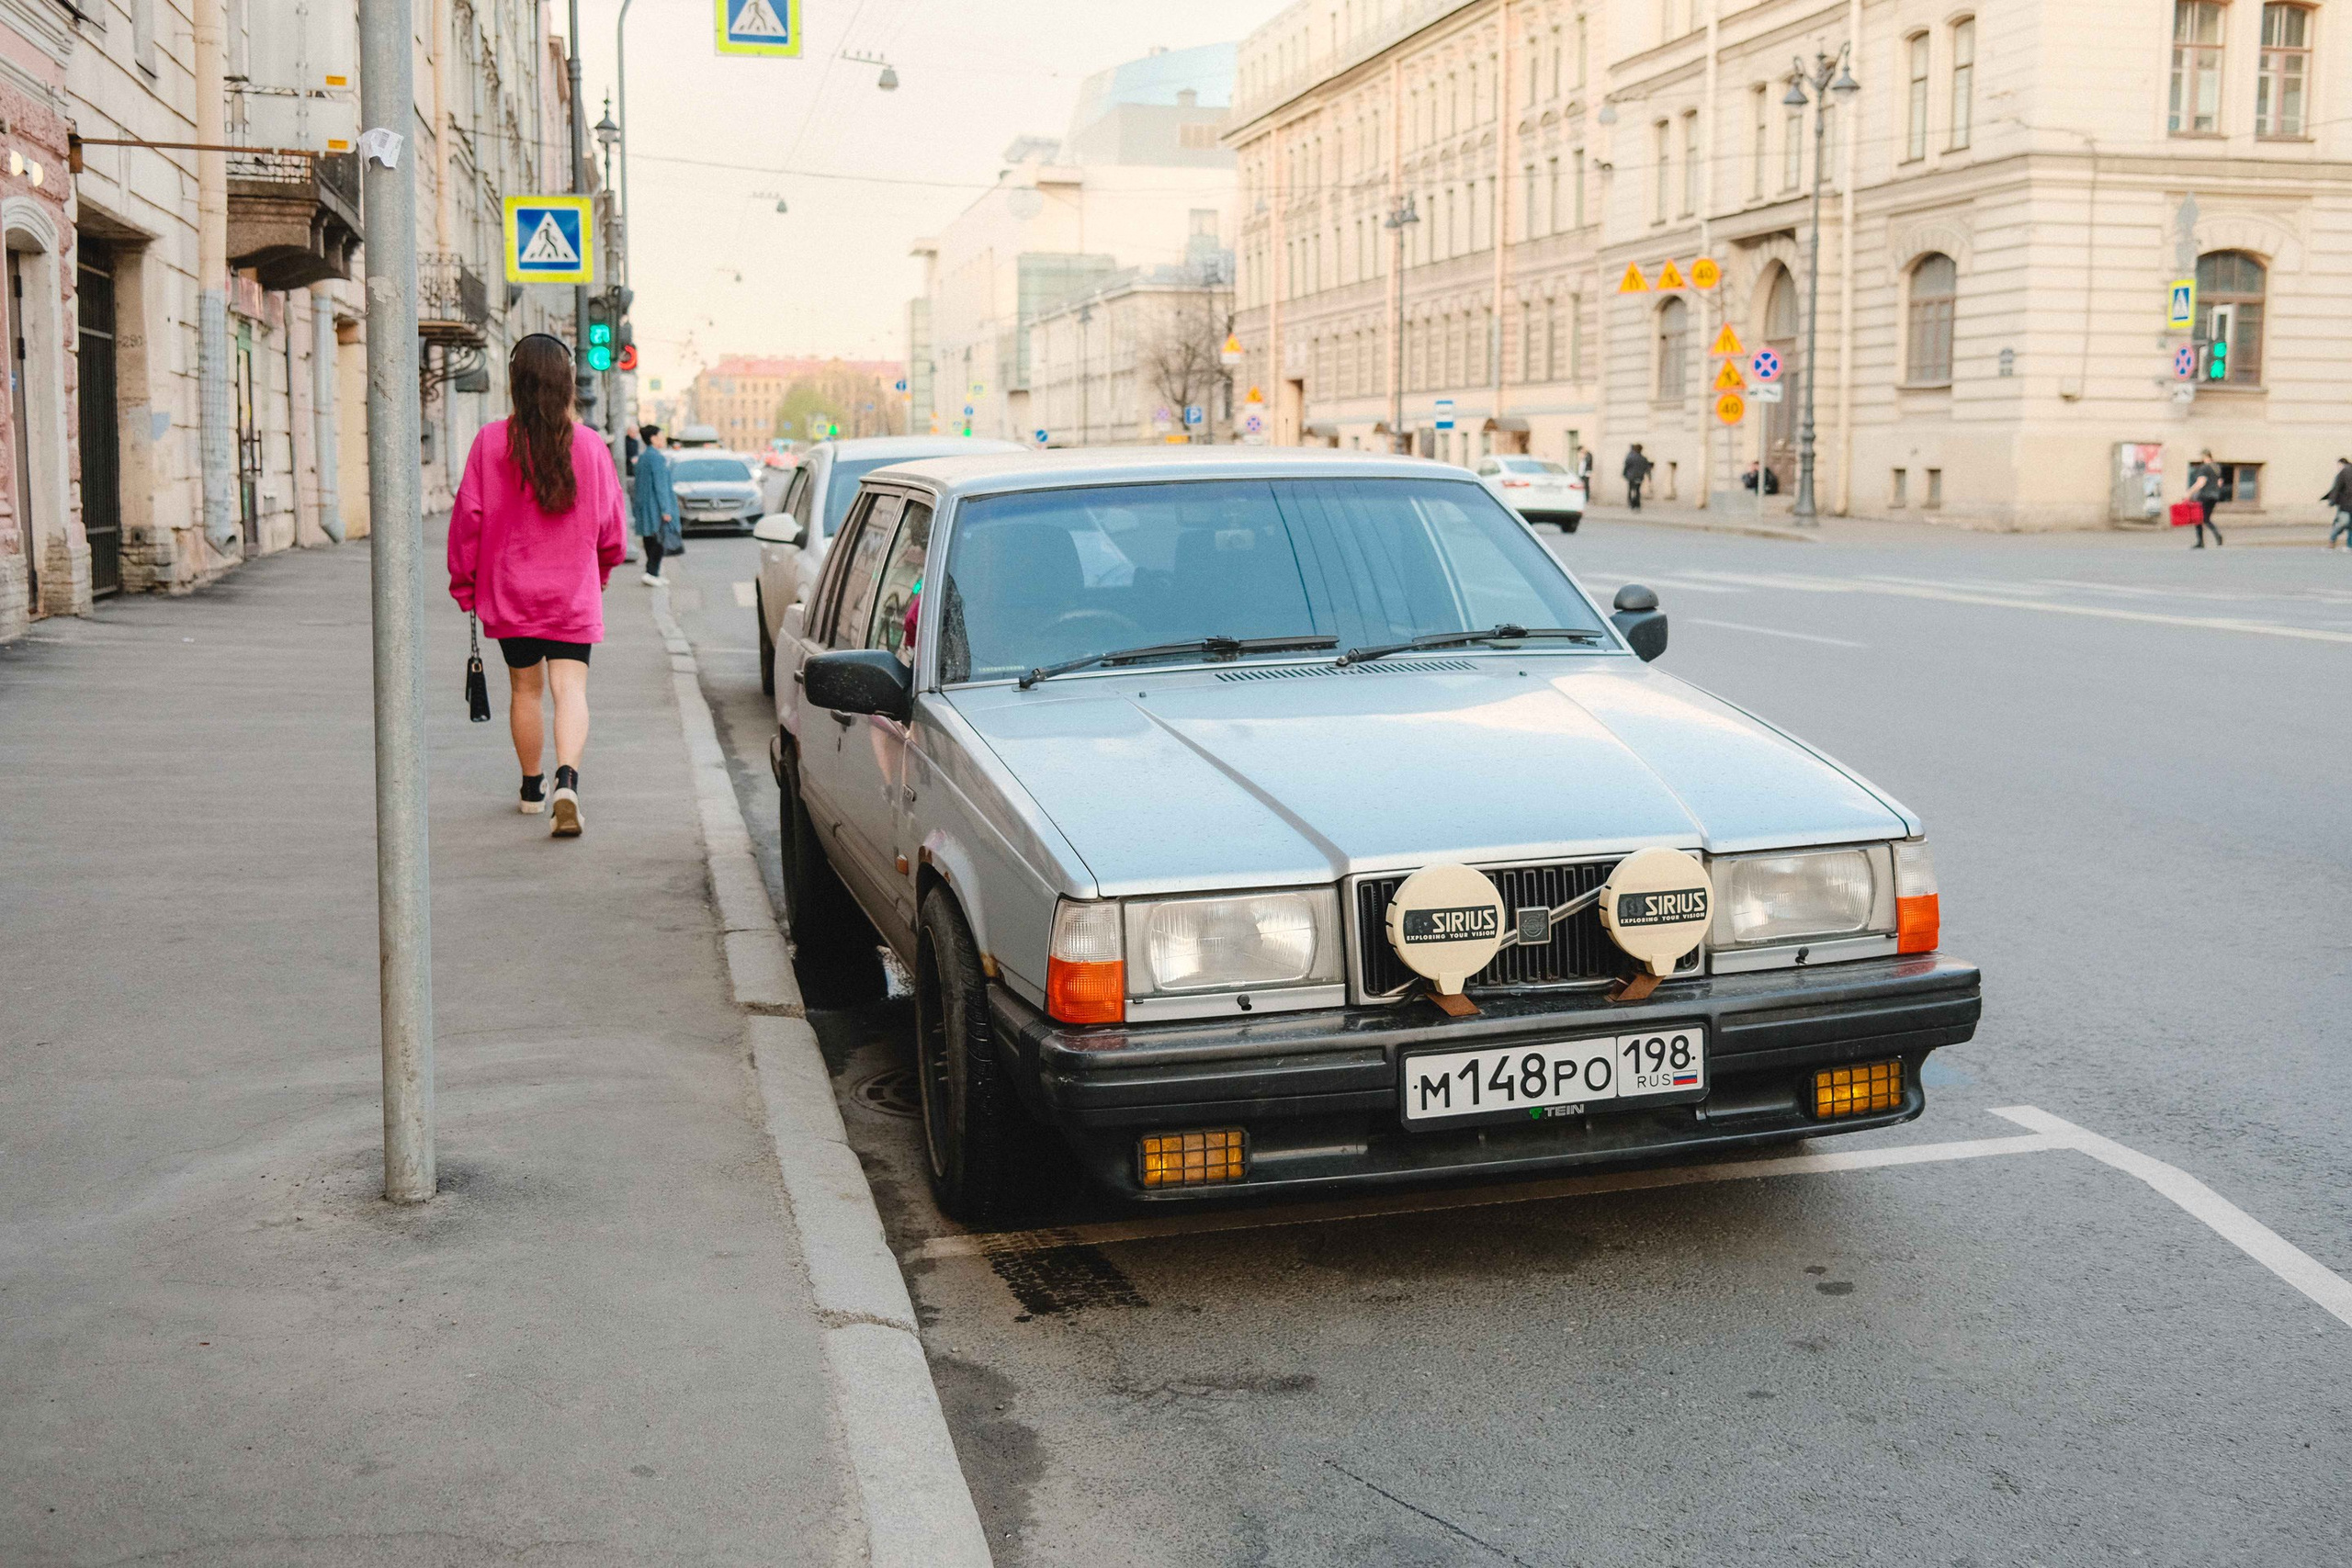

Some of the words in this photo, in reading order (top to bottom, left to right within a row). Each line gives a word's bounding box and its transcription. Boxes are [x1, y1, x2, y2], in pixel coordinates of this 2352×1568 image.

[1697, 266, 1713, 279] 40
[1723, 402, 1738, 413] 40
[1645, 891, 1705, 917] SIRIUS
[1431, 908, 1496, 933] SIRIUS
[1620, 916, 1658, 924] EXPLORING
[1682, 911, 1706, 919] VISION
[1623, 1034, 1690, 1075] 198
[1636, 1073, 1671, 1089] RUS
[1544, 1103, 1586, 1117] TEIN
